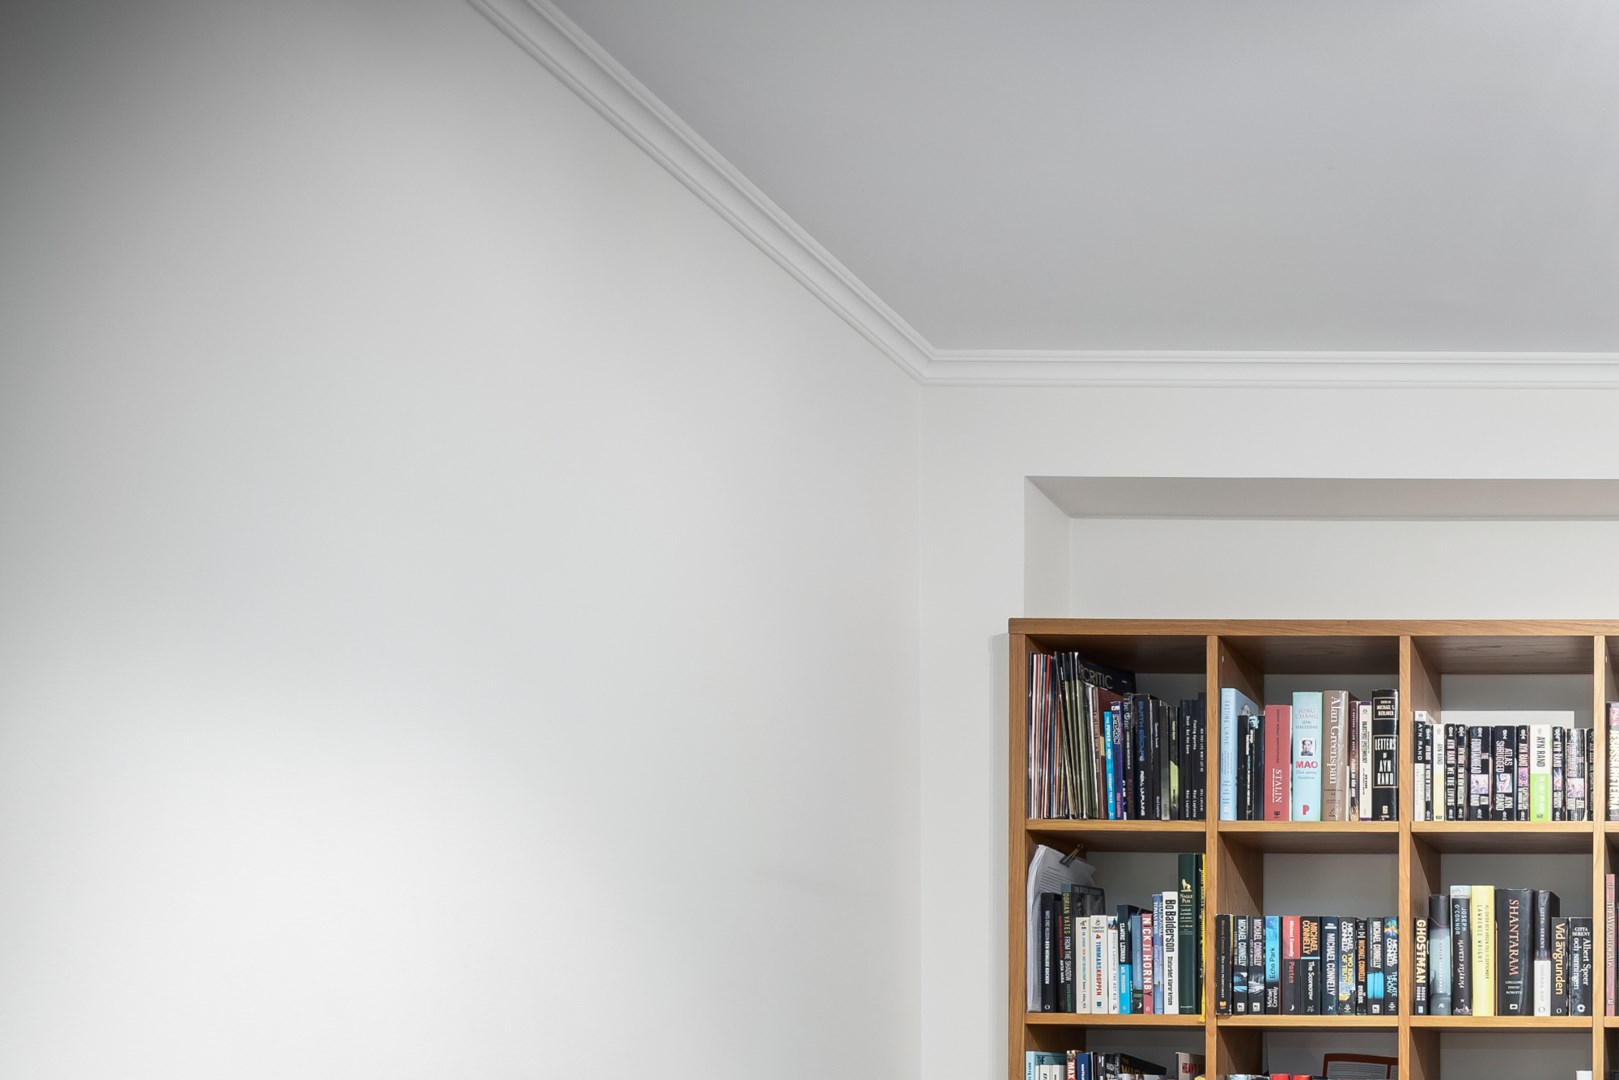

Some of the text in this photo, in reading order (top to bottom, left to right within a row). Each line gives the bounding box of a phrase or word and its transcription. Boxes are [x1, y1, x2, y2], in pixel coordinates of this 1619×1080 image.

[1327, 696, 1341, 784] Alan Greenspan
[1496, 741, 1504, 772] SHRUGGED
[1504, 748, 1512, 765] ATLAS
[1537, 736, 1545, 767] AYN RAND
[1377, 773, 1393, 785] RAND
[1609, 730, 1619, 809] JESUSSKRIFTERNA
[1166, 900, 1176, 952] Bo Balderson
[1509, 899, 1519, 975] SHANTARAM
[1143, 955, 1152, 996] HORNBY
[1327, 933, 1335, 995] MICHAEL CONNELLY
[1416, 920, 1426, 983] GHOSTMAN
[1581, 938, 1591, 985] Albert Speer
